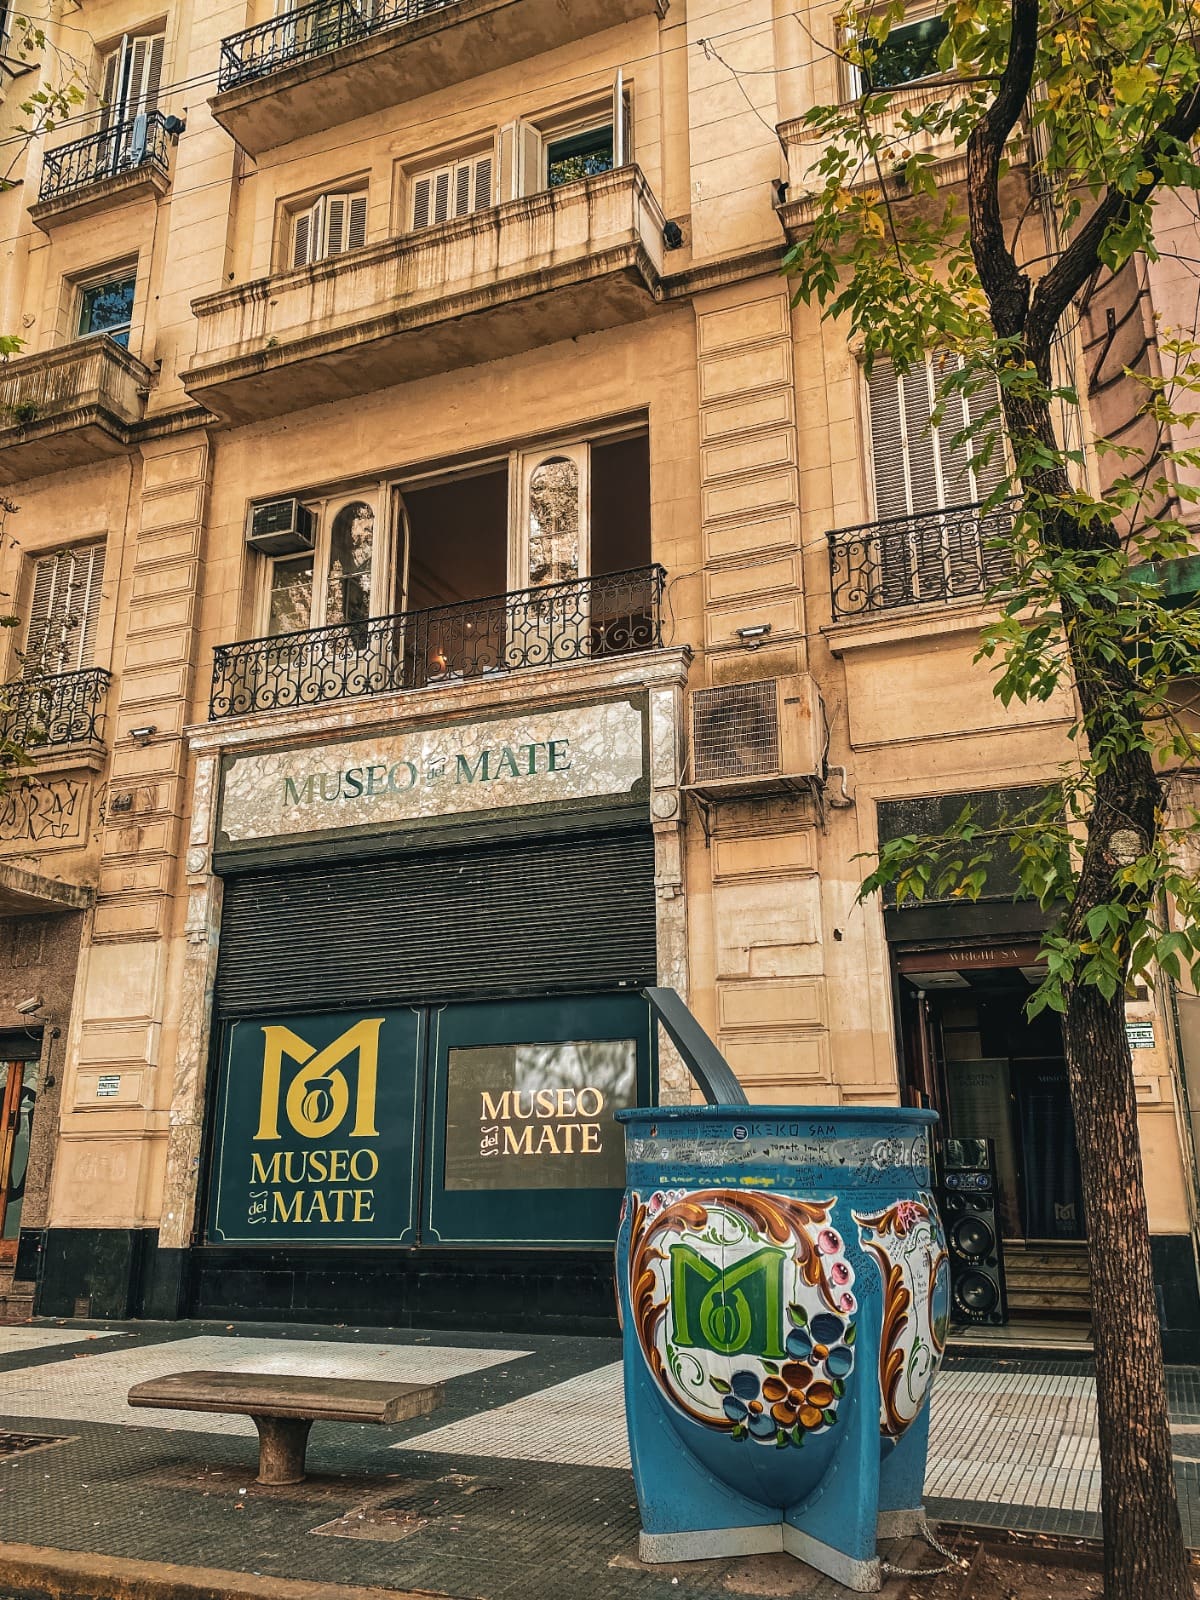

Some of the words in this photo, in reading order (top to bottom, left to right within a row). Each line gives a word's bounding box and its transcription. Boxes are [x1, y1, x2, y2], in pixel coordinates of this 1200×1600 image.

[281, 760, 419, 808] MUSEO
[426, 764, 447, 781] del
[454, 738, 573, 785] MATE
[479, 1086, 605, 1121] MUSEO
[480, 1132, 499, 1149] del
[502, 1122, 603, 1155] MATE
[808, 1124, 837, 1137] SAM
[249, 1148, 380, 1184] MUSEO
[248, 1198, 268, 1216] del
[270, 1188, 376, 1223] MATE
